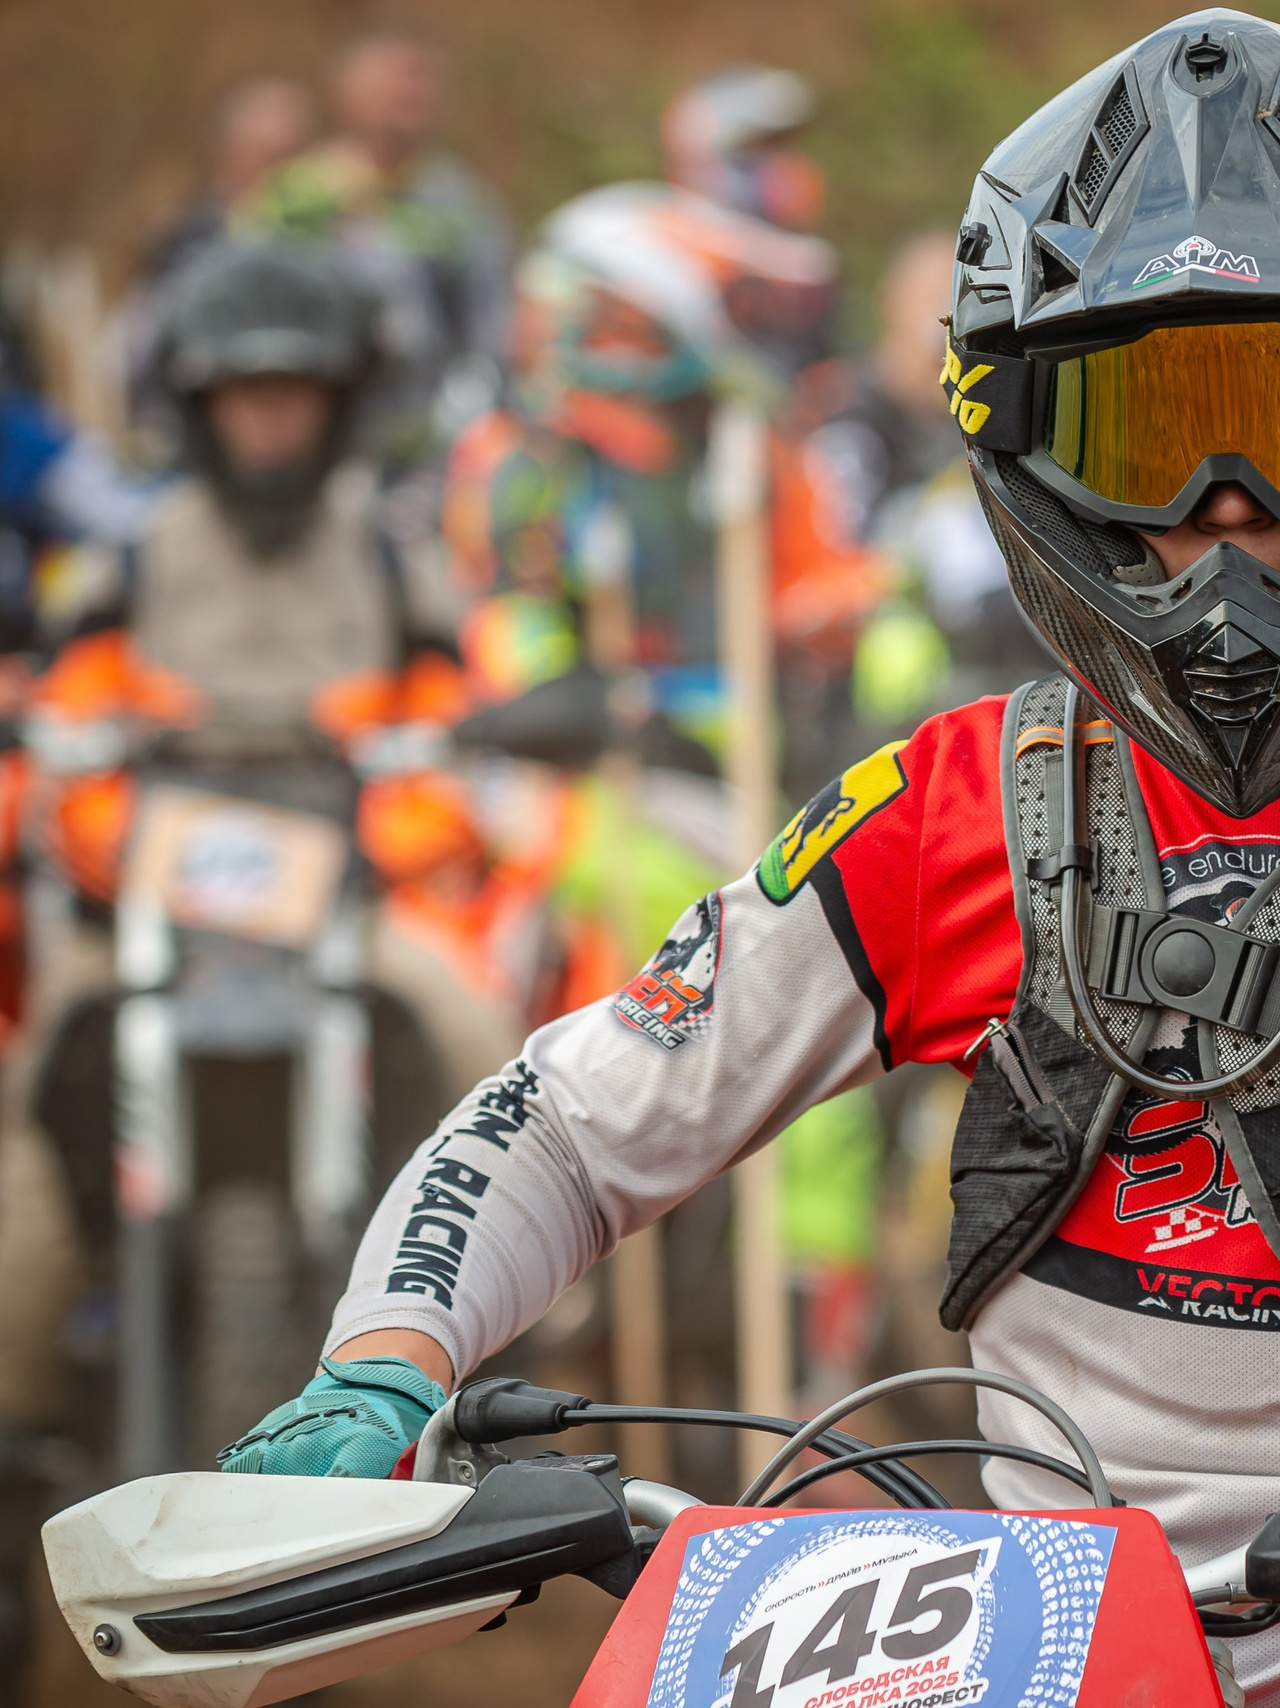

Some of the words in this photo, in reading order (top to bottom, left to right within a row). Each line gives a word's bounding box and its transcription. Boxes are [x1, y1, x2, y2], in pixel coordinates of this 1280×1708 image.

[764, 1584, 817, 1613] СКОРОСТЬ
[825, 1566, 862, 1586] ДРАЙВ
[871, 1548, 918, 1568] МУЗЫКА
[718, 1548, 982, 1708] 145
[804, 1656, 951, 1708] СЛОБОДСКАЯ
[905, 1671, 959, 1698] 2025
